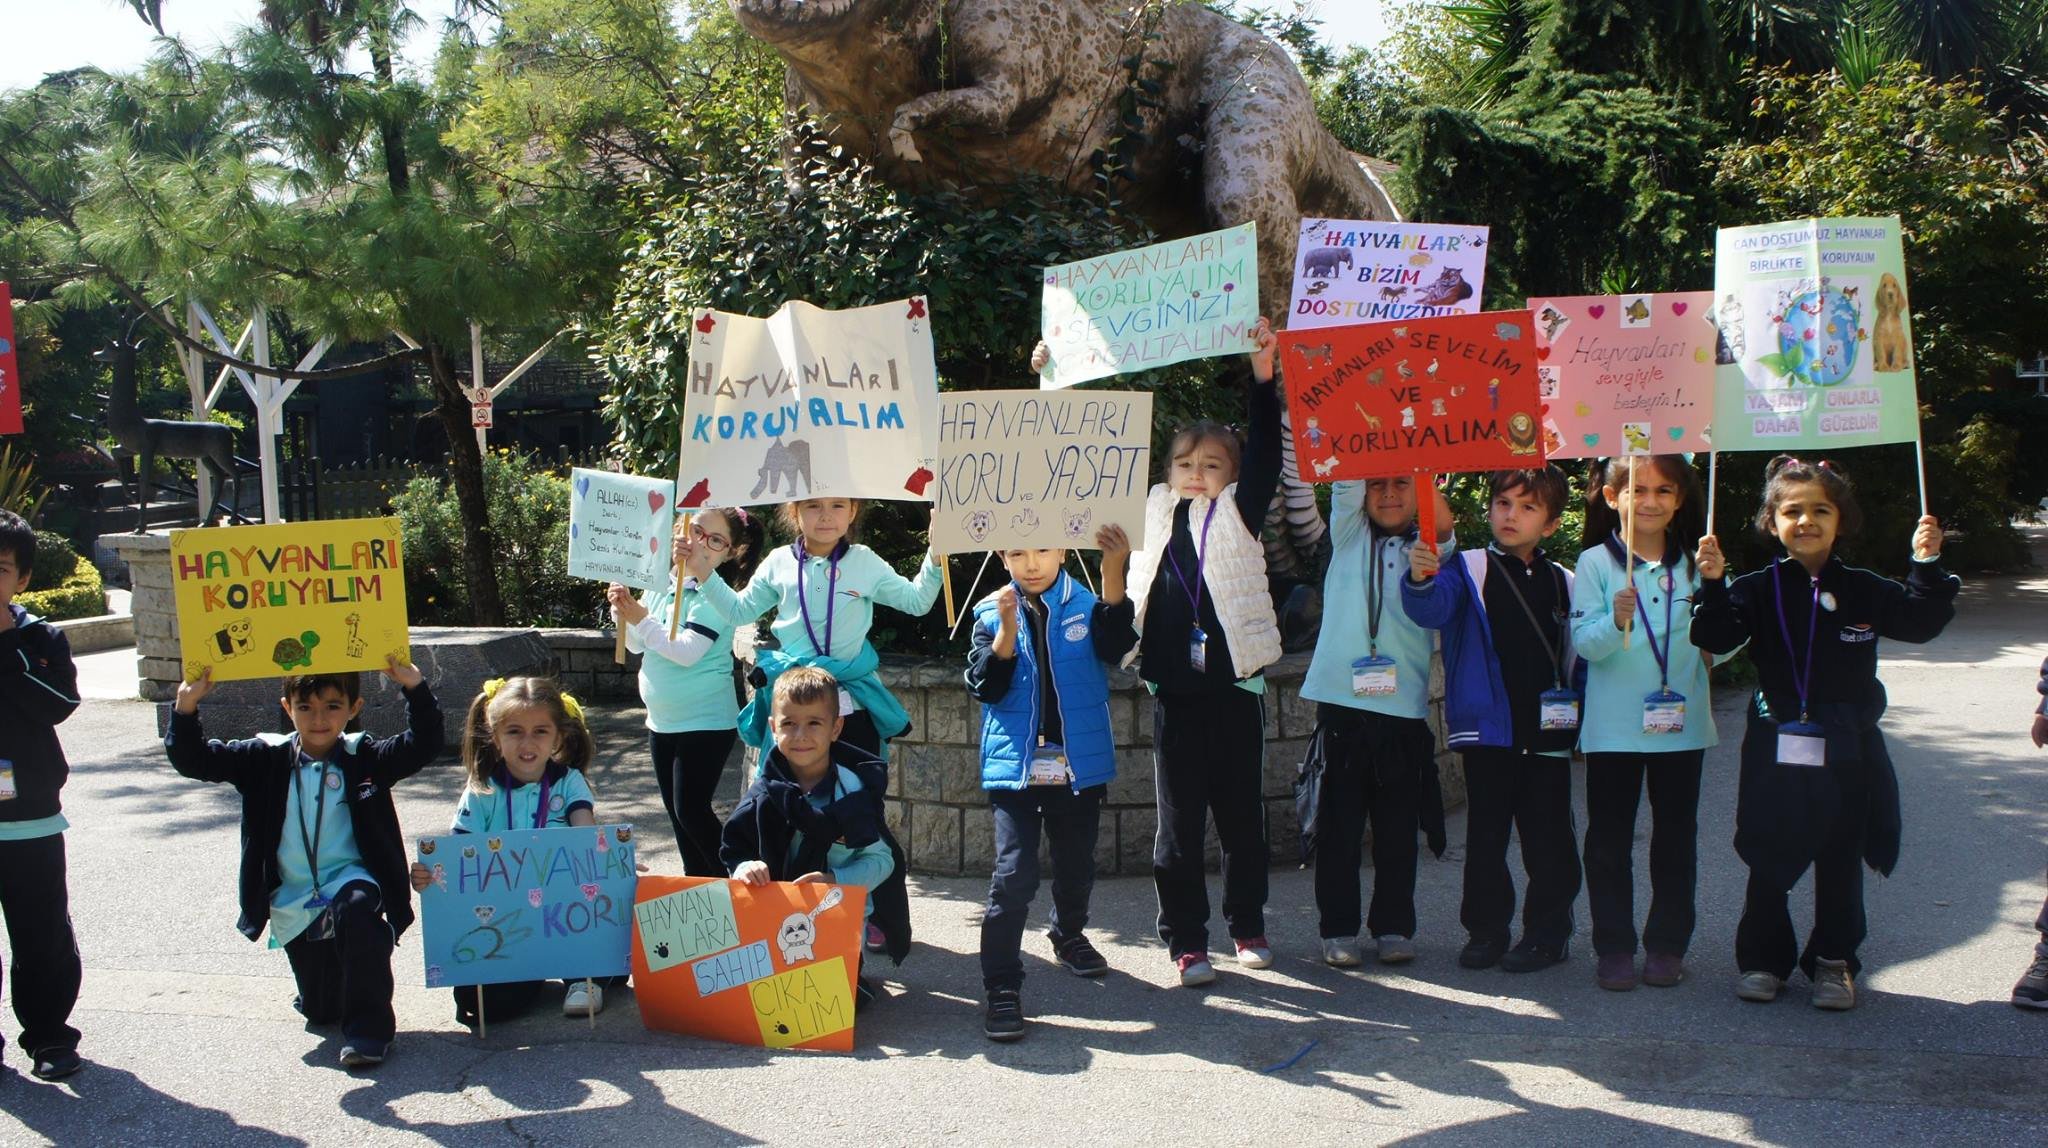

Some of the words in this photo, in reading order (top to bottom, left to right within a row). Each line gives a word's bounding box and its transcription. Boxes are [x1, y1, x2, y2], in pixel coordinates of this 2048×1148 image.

[1324, 231, 1461, 251] HAYVANLAR
[1835, 228, 1886, 240] HAYVANLARI
[1054, 236, 1224, 289] HAYVANLARI
[1357, 263, 1421, 285] BİZİM
[1822, 251, 1875, 264] KORUYALIM
[1073, 258, 1244, 314] KORUYALIM
[1300, 337, 1395, 411] HAYVANLARI
[1408, 332, 1523, 377] SEVELİM
[1595, 366, 1665, 392] sevgiyle
[1390, 385, 1422, 403] VE
[1825, 388, 1881, 407] ONLARLA
[691, 397, 905, 443] KORUYALIM
[940, 399, 1131, 443] HAYVANLARI
[1330, 419, 1497, 455] KORUYALIM
[1754, 418, 1800, 434] DAHA
[1819, 412, 1879, 433] GÜZELDİR
[939, 451, 1020, 512] KORU
[1039, 444, 1149, 503] YAŞAT
[178, 539, 398, 580] HAYVANLARI
[202, 574, 382, 612] KORUYALIM
[638, 888, 715, 937] HAYVAN
[678, 915, 740, 959] LARA
[696, 943, 768, 996] SAHİP
[794, 995, 845, 1040] LIM
